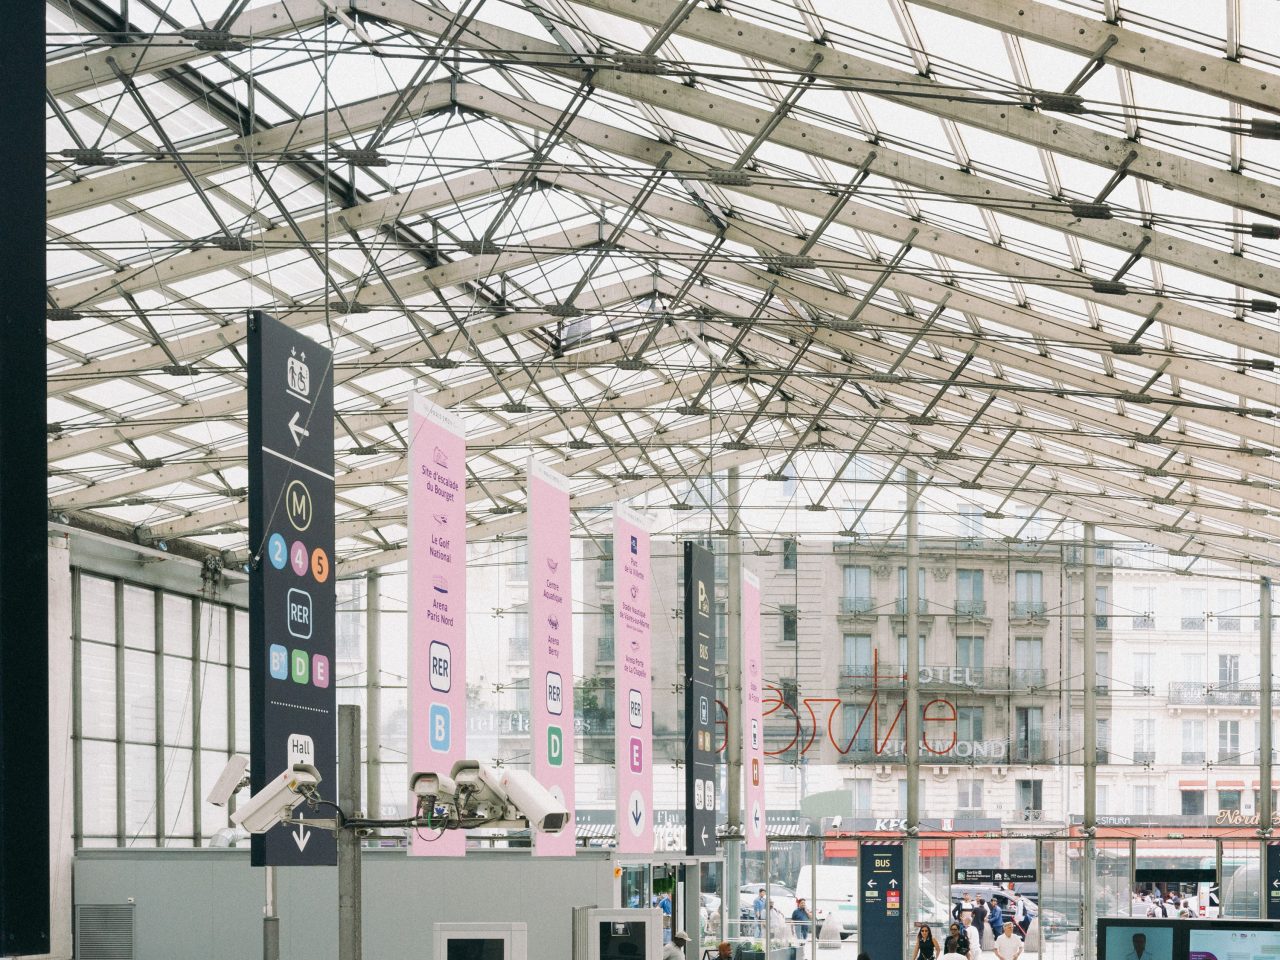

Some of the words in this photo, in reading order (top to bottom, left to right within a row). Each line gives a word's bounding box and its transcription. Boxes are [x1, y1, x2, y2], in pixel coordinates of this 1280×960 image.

[422, 465, 434, 479] Site
[433, 468, 459, 492] d'escalade
[426, 481, 434, 492] du
[435, 484, 455, 503] Bourget
[292, 491, 306, 521] M
[431, 534, 439, 546] Le
[439, 537, 451, 549] Golf
[274, 543, 283, 562] 2
[294, 548, 303, 569] 4
[317, 556, 324, 577] 5
[429, 548, 452, 564] National
[290, 603, 310, 625] RER
[432, 599, 448, 612] Arena
[426, 609, 440, 624] Paris
[441, 613, 454, 627] Nord
[699, 643, 709, 660] BUS
[271, 651, 280, 671] B
[296, 656, 306, 677] D
[316, 661, 325, 681] E
[431, 656, 449, 678] RER
[548, 684, 561, 702] RER
[630, 701, 642, 717] RER
[434, 713, 446, 743] B
[291, 738, 311, 755] Hall
[551, 733, 560, 758] D
[633, 744, 640, 767] E
[753, 763, 759, 781] H
[1216, 809, 1260, 826] Nord
[875, 859, 890, 867] BUS
